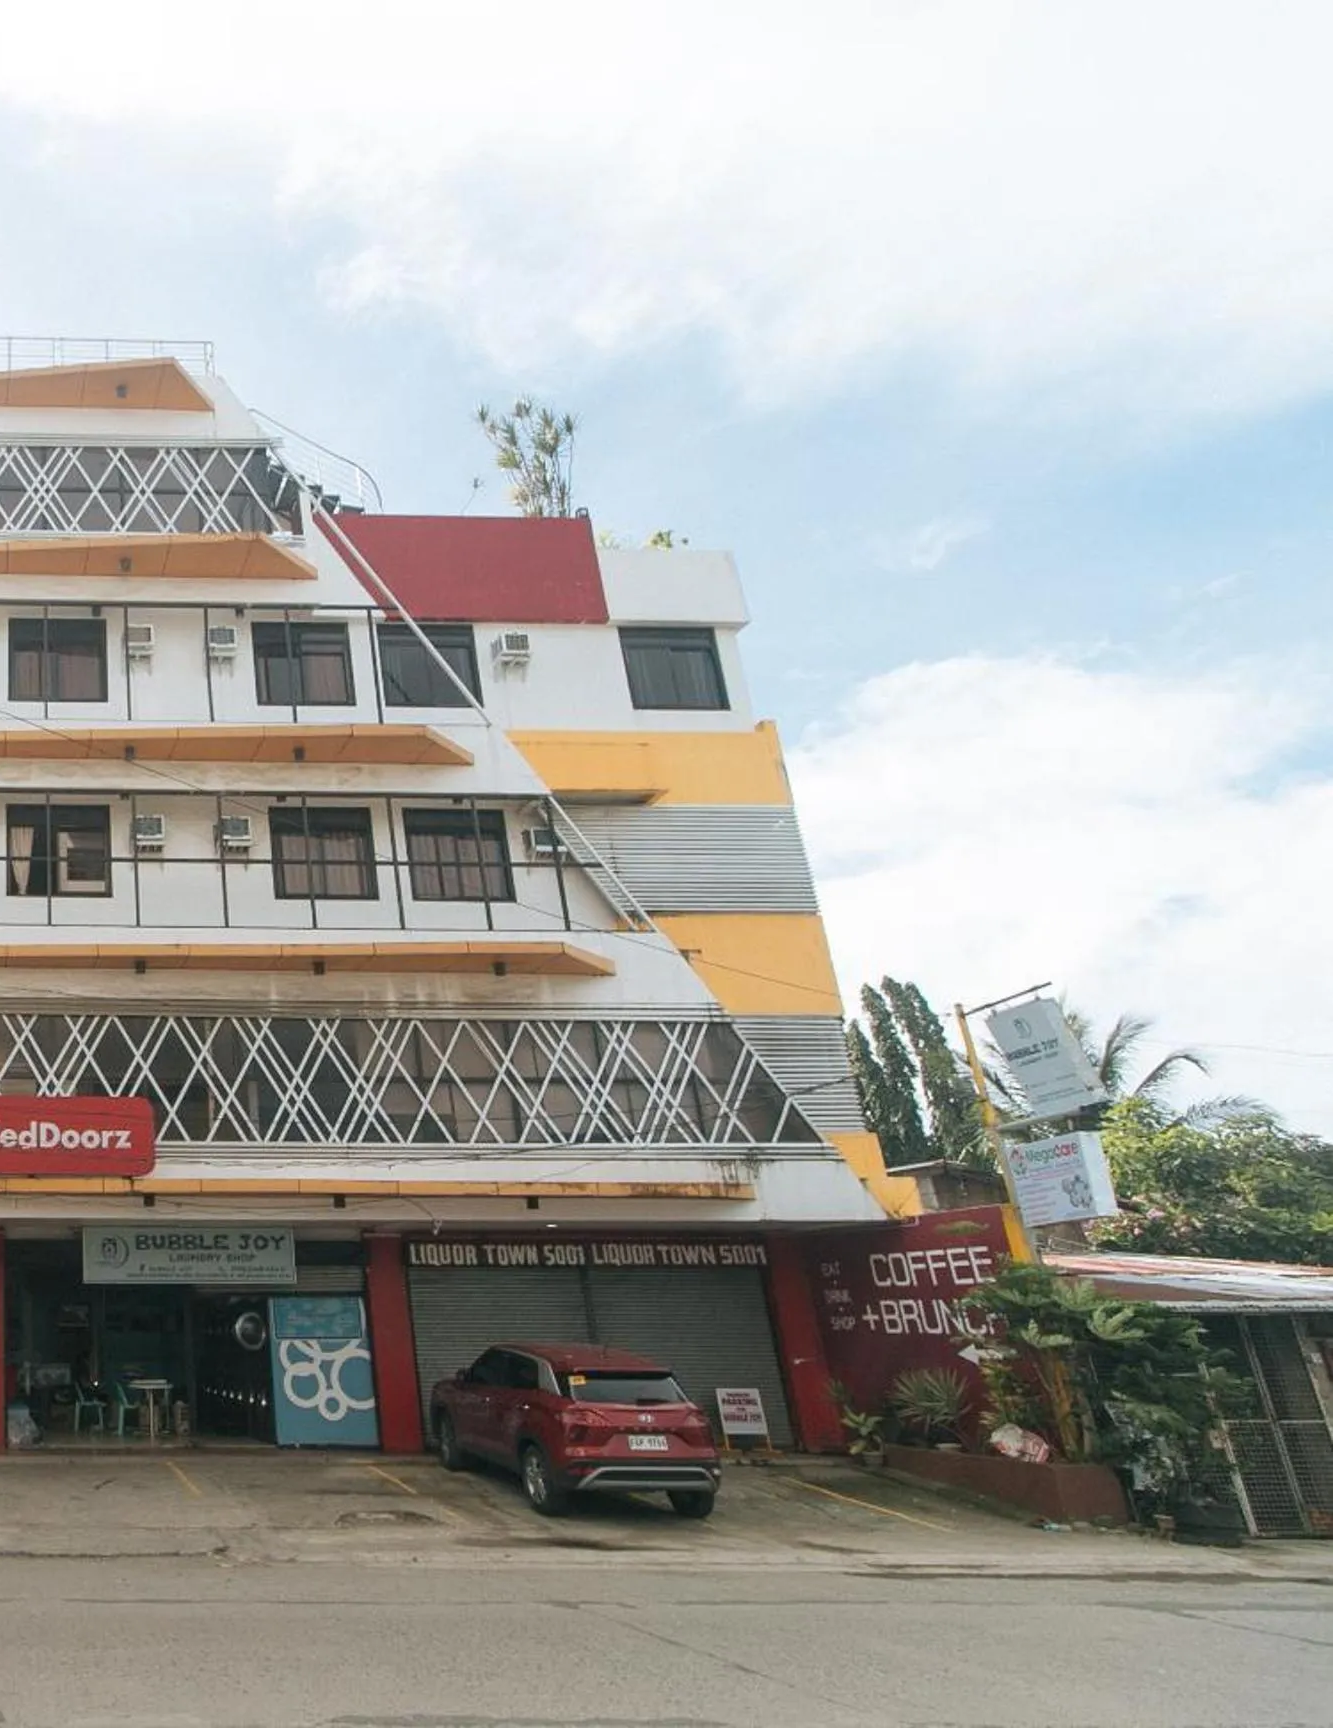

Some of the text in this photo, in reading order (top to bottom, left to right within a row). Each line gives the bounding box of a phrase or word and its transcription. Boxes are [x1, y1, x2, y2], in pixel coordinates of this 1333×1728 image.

[134, 1233, 287, 1251] BUBBLE JOY
[168, 1253, 257, 1263] LAUNDRY SHOP
[409, 1243, 479, 1267] LIQUOR
[486, 1244, 539, 1266] TOWN
[592, 1244, 655, 1265] LIQUOR
[657, 1244, 717, 1265] TOWN
[869, 1246, 997, 1288] COFFEE
